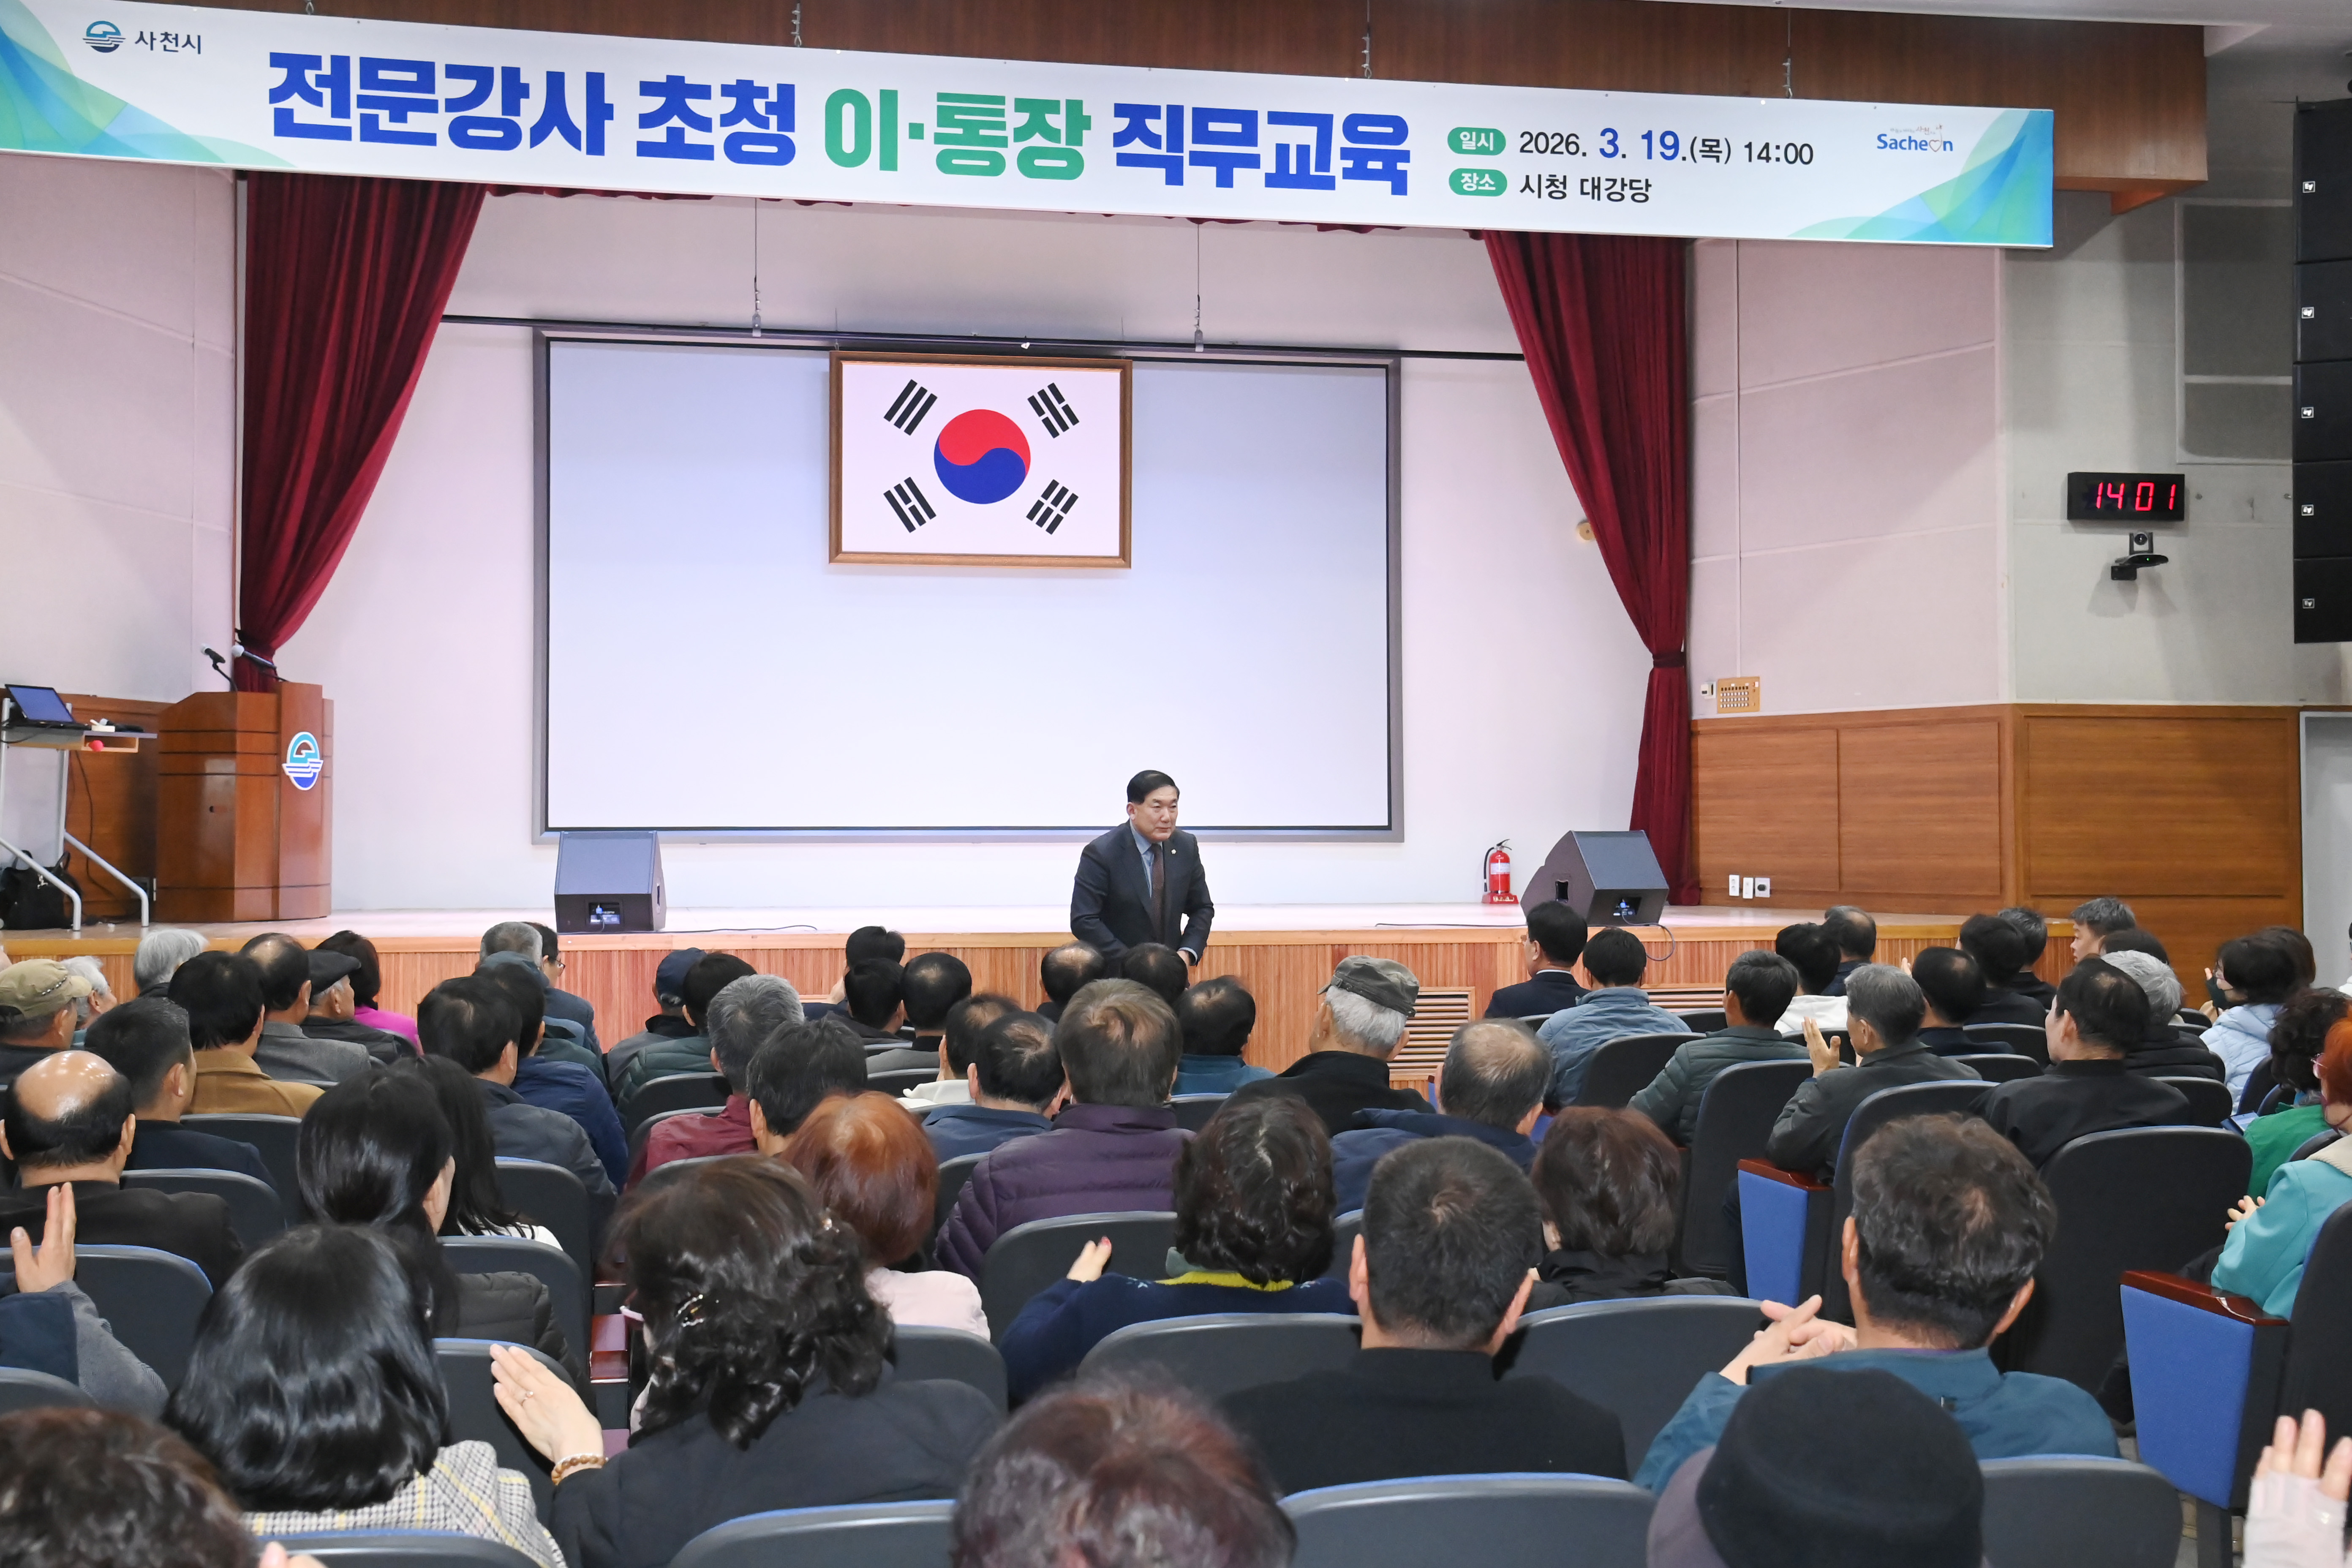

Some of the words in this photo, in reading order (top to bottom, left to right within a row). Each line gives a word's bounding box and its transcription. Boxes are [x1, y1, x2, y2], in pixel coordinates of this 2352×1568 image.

[135, 30, 201, 54] 사천시
[269, 52, 614, 156] 전문강사
[636, 74, 796, 166] 초청
[825, 88, 1092, 180] 이·통장
[1113, 103, 1411, 196] 직무교육
[1460, 131, 1494, 151] 일시
[1519, 131, 1587, 157] 2026.
[1599, 128, 1626, 158] 3.
[1641, 130, 1731, 164] 19.(목)
[1744, 142, 1813, 165] 14:00
[1460, 173, 1496, 191] 장소
[1519, 174, 1567, 200] 시청
[1580, 176, 1652, 203] 대강당
